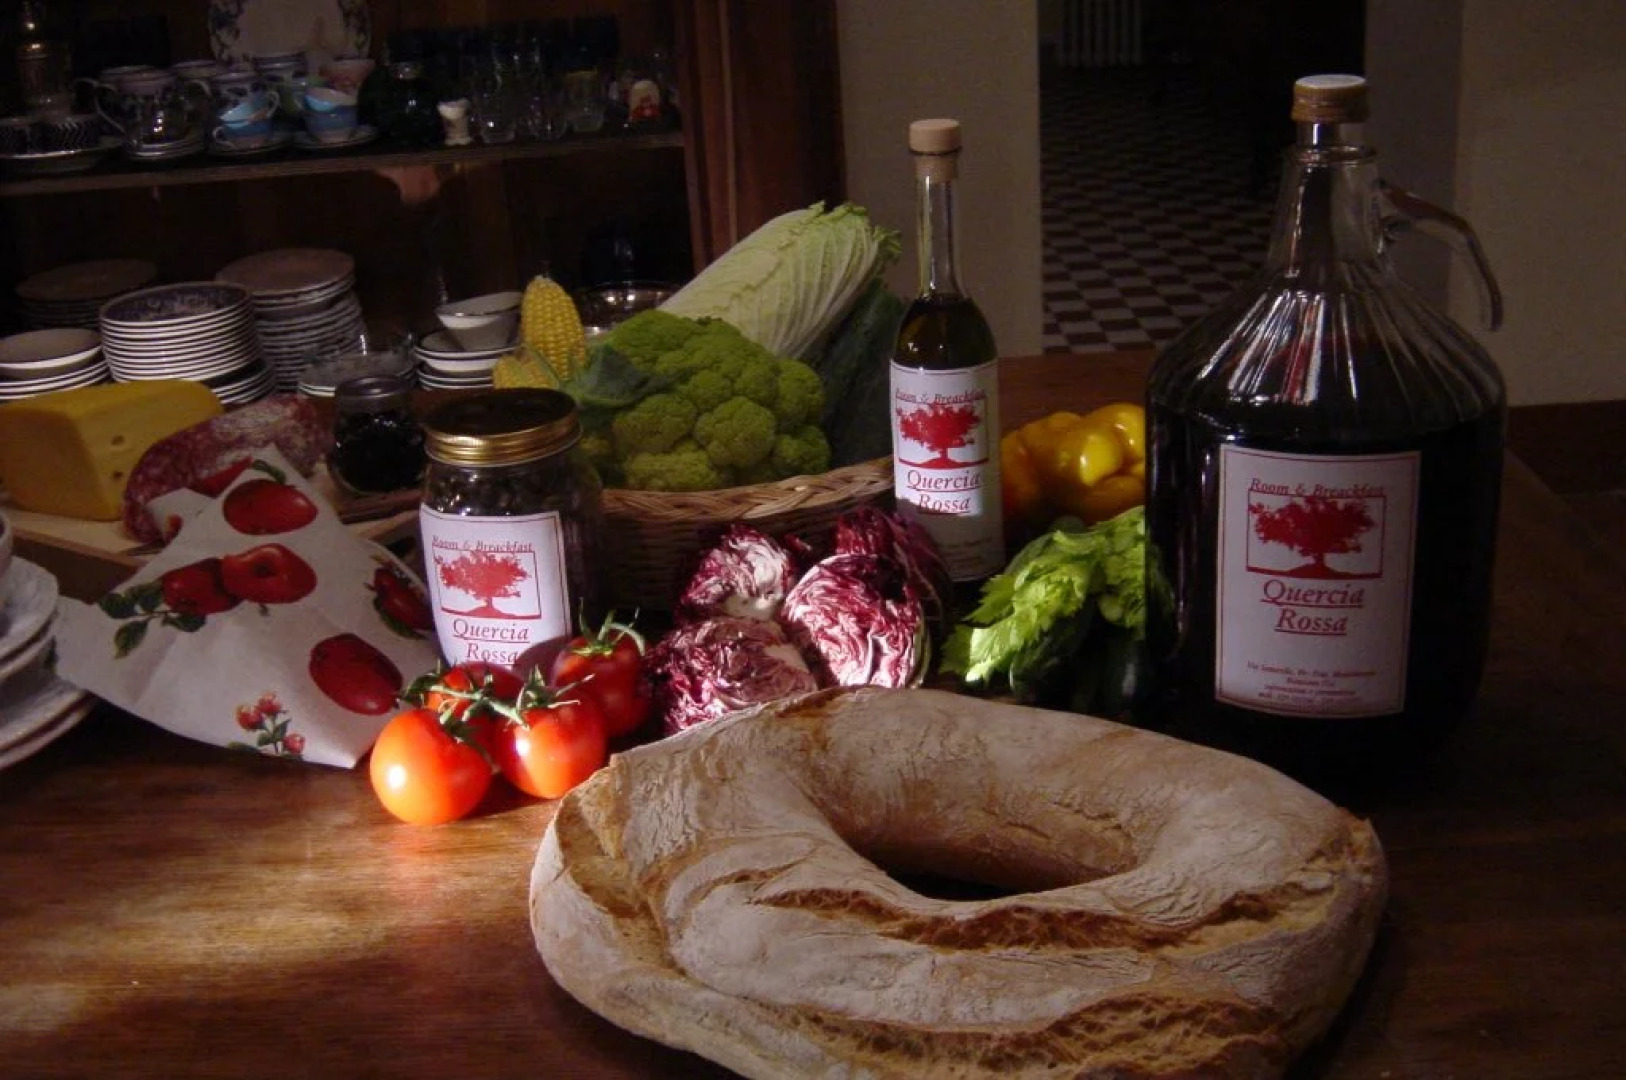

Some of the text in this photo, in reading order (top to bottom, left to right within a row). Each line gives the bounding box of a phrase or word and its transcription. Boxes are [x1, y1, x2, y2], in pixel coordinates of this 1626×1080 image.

[907, 469, 980, 489] Quercia
[1250, 477, 1289, 495] Room
[919, 493, 971, 511] Rossa
[1262, 579, 1366, 605] Quercia
[453, 618, 530, 641] Quercia
[1276, 608, 1348, 633] Rossa
[466, 642, 518, 663] Rossa
